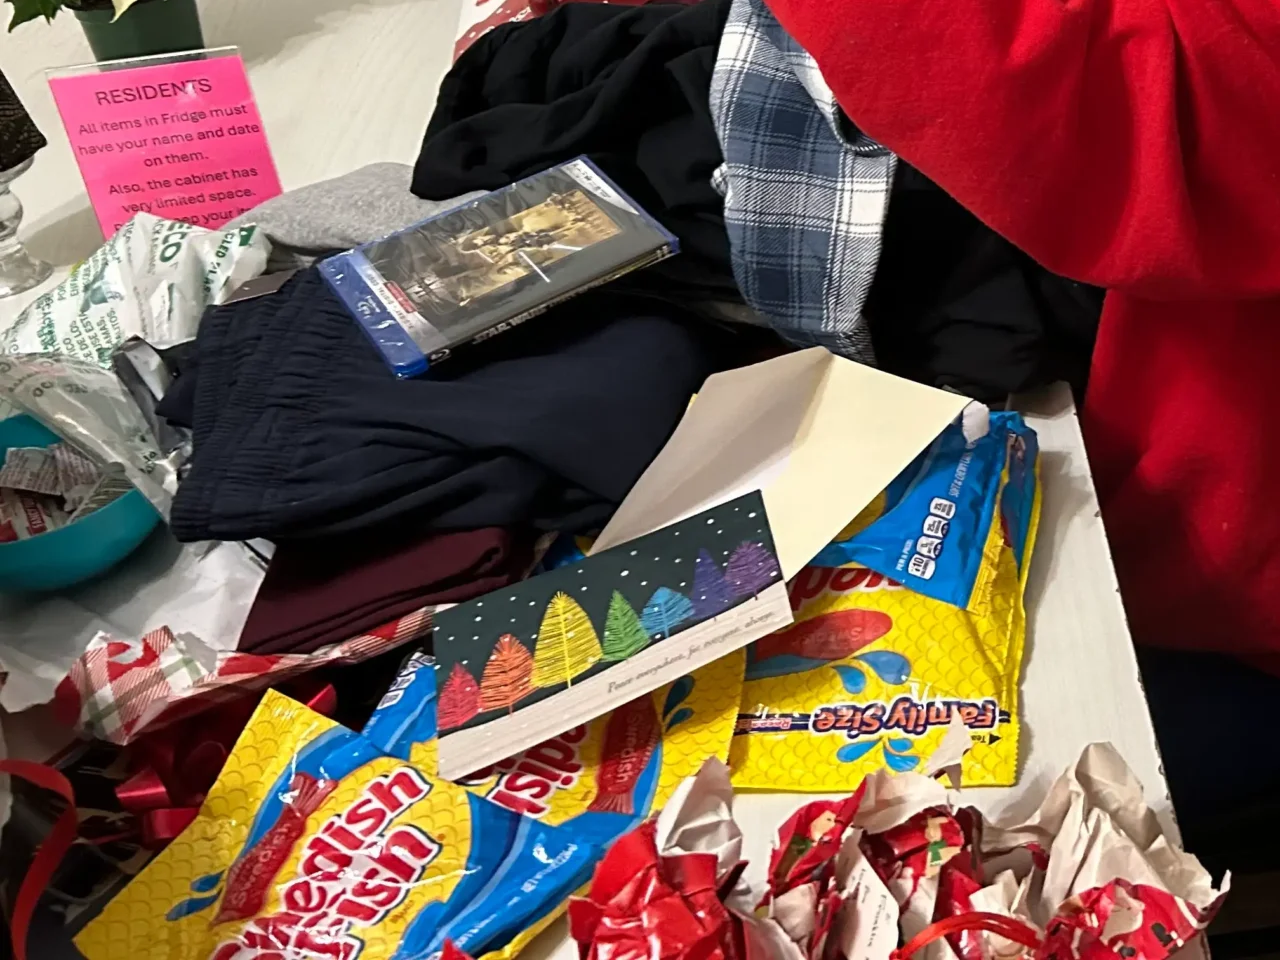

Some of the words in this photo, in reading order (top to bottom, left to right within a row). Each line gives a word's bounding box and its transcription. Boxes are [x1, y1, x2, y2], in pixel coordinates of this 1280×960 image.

[95, 77, 213, 106] RESIDENTS
[78, 123, 98, 136] All
[101, 118, 142, 134] items
[145, 114, 159, 127] in
[161, 109, 207, 125] Fridge
[209, 104, 248, 118] must
[78, 140, 115, 156] have
[117, 137, 149, 155] your
[152, 132, 194, 147] name
[196, 126, 225, 141] and
[227, 122, 260, 137] date
[144, 155, 163, 168] on
[165, 150, 209, 165] them.
[108, 181, 145, 195] Also,
[147, 175, 172, 189] the
[174, 169, 229, 187] cabinet
[231, 166, 258, 180] has
[122, 200, 153, 214] very
[156, 192, 206, 209] limited
[208, 187, 257, 204] space.
[202, 208, 235, 225] your
[811, 700, 886, 738] Size
